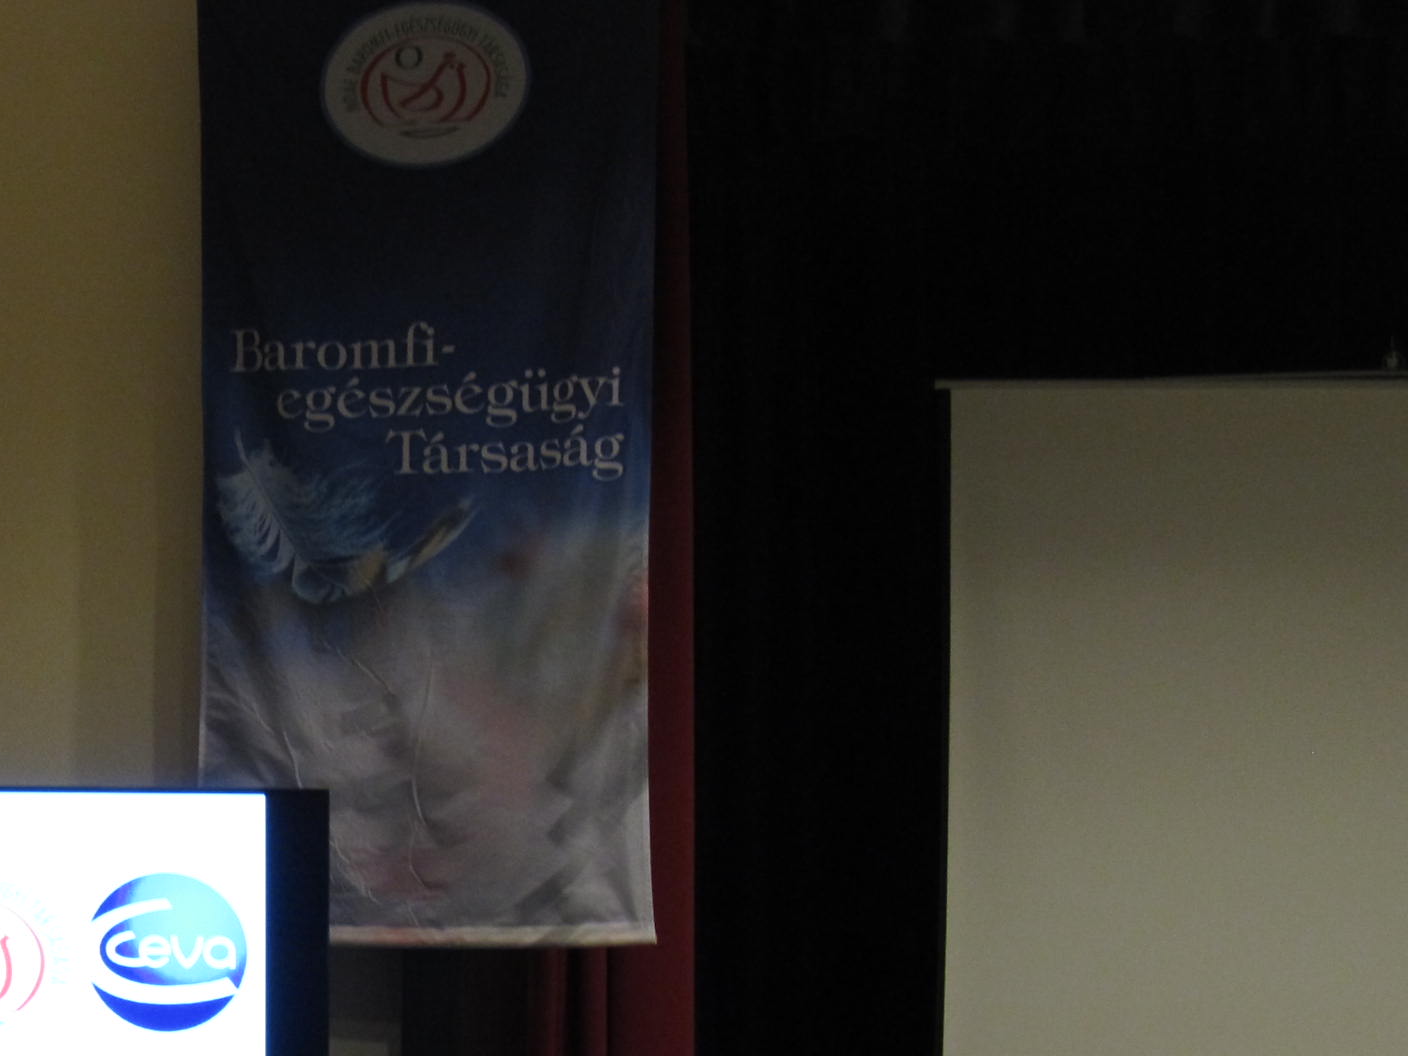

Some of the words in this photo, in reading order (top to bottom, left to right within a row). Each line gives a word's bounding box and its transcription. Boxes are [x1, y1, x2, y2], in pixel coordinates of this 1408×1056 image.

[231, 321, 456, 374] Baromfi-
[276, 366, 624, 434] egészségügyi
[384, 424, 625, 482] Társaság
